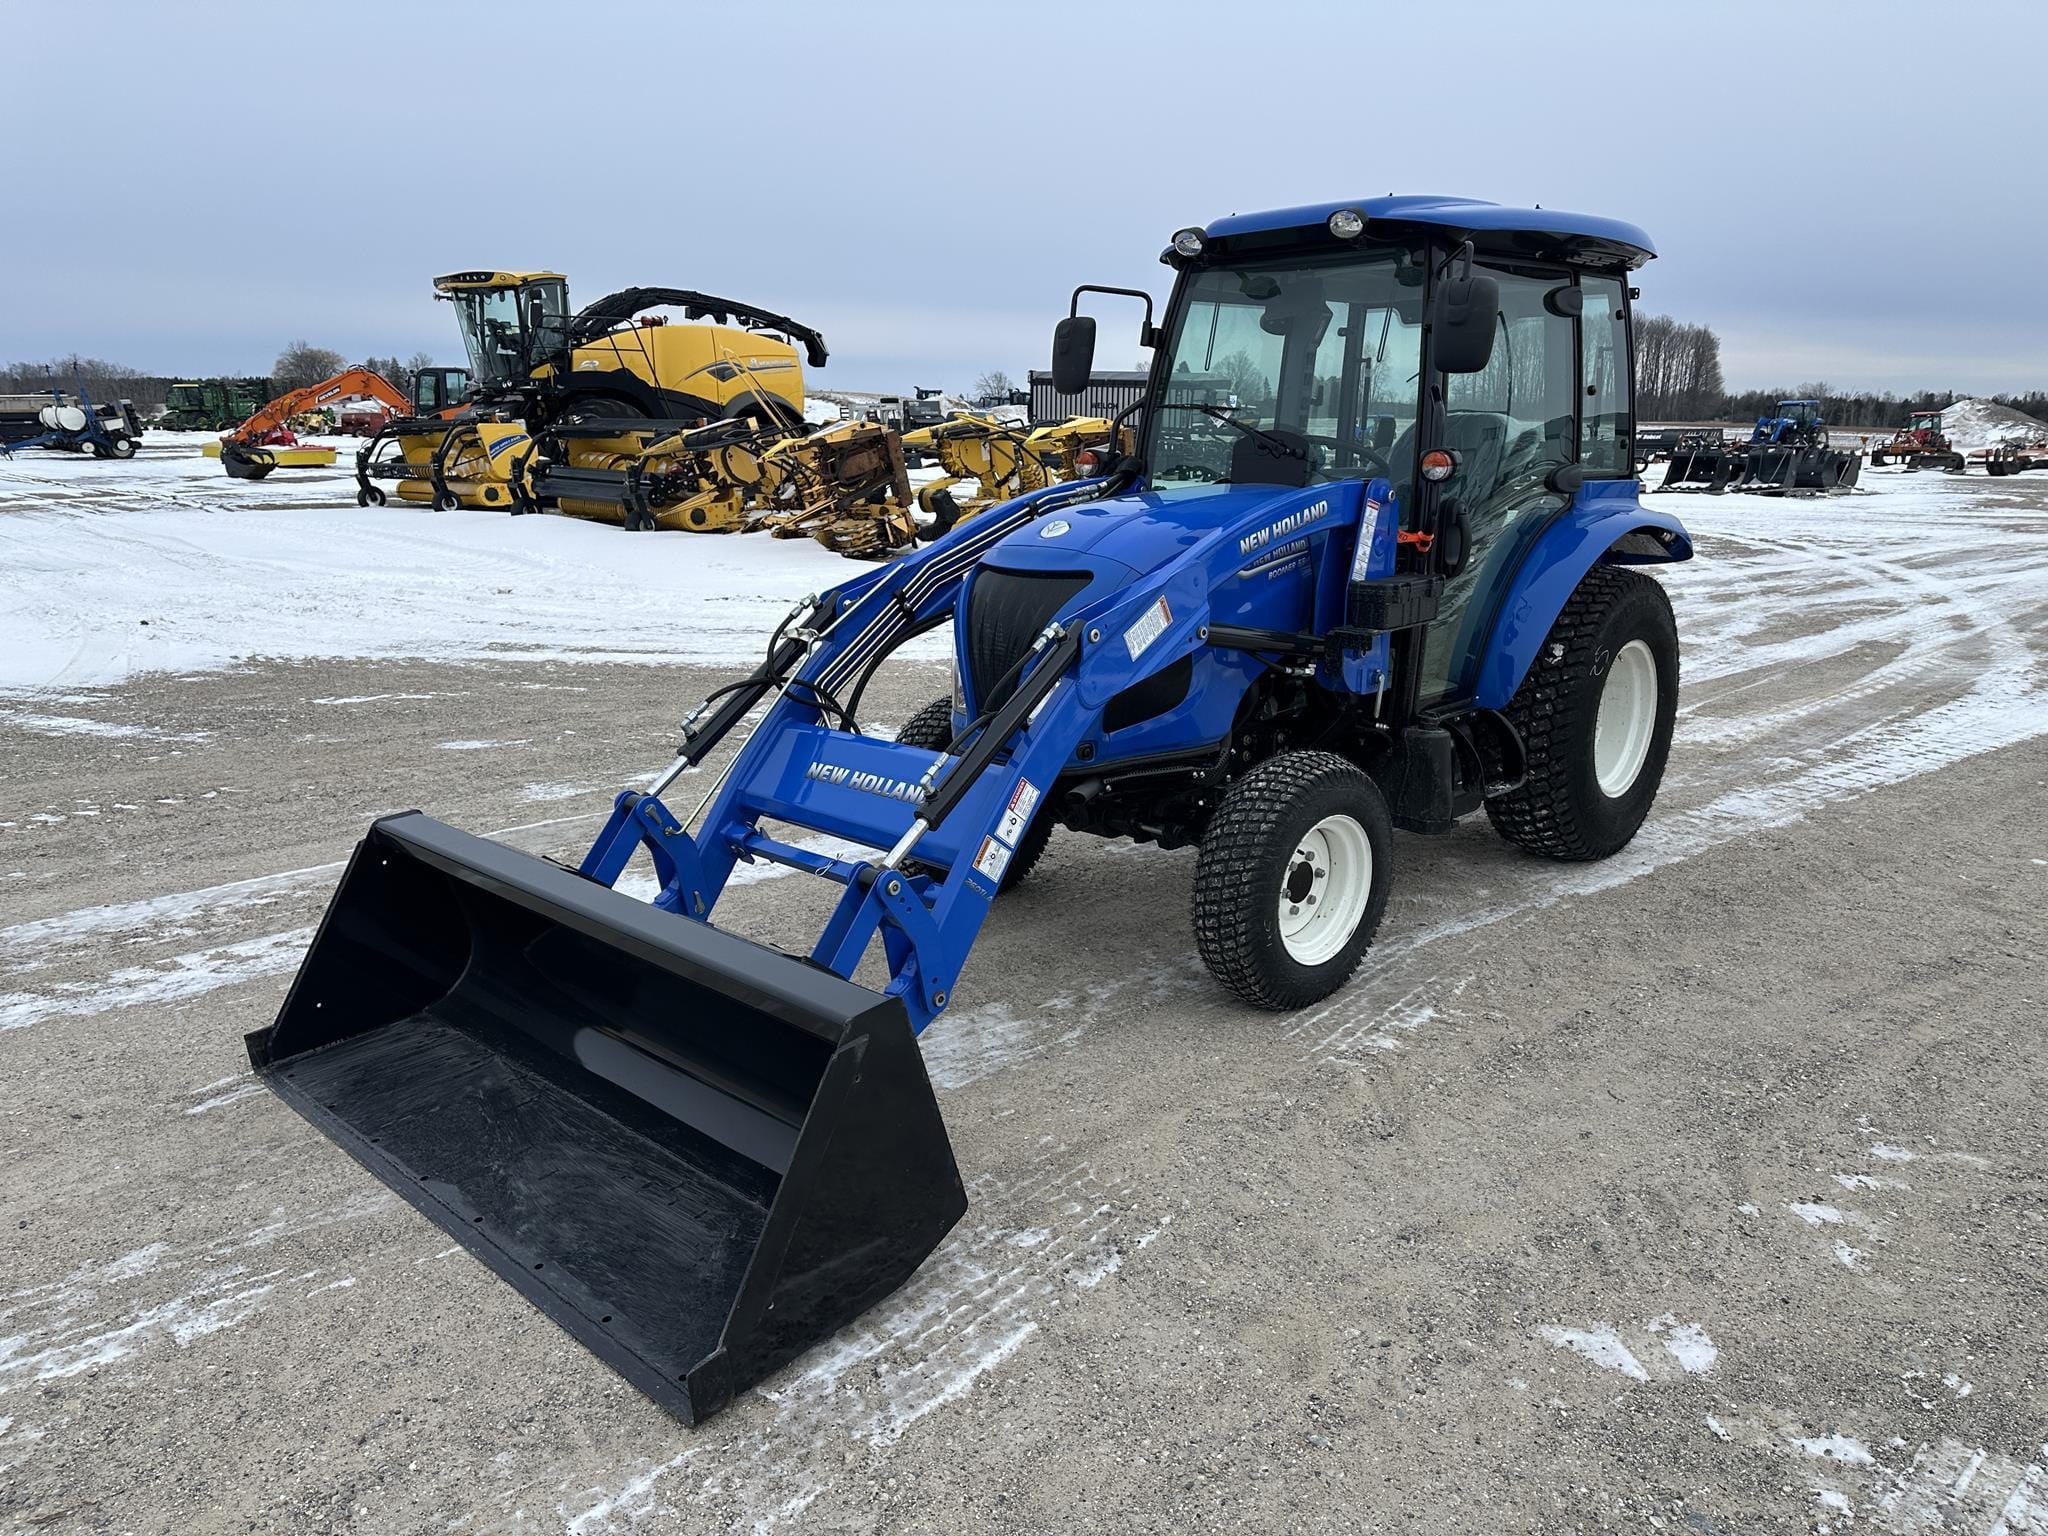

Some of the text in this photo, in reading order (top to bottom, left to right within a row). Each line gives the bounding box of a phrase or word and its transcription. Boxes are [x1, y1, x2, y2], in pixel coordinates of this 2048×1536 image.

[1240, 527, 1270, 556] NEW
[1272, 500, 1328, 540] HOLLAND
[1272, 539, 1306, 559] HOLLAND
[1268, 562, 1297, 580] BOOMER
[806, 761, 850, 785] NEW
